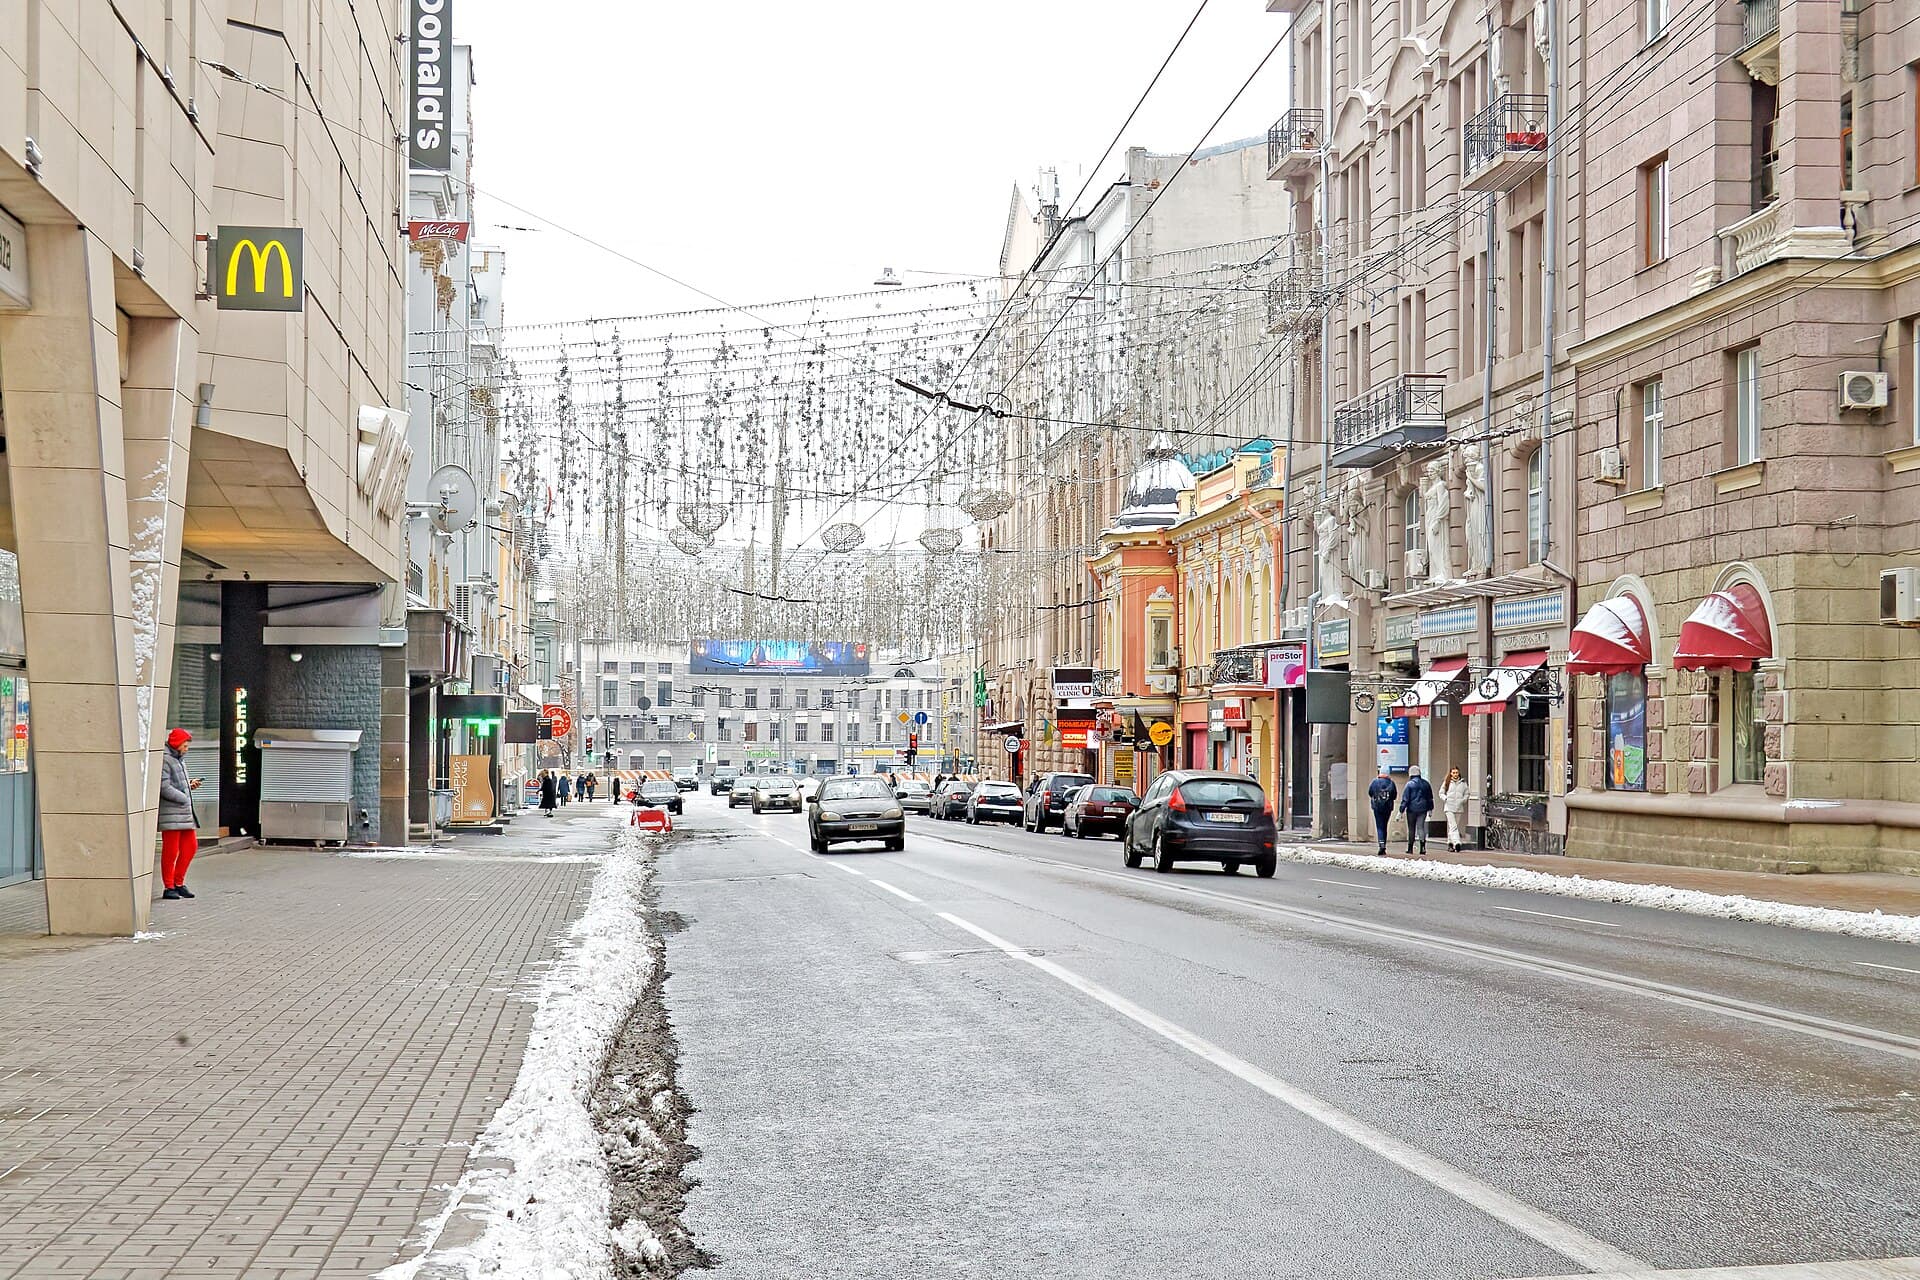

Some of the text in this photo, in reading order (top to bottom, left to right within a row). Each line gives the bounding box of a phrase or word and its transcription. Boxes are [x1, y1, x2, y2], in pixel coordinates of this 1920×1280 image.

[1270, 652, 1303, 662] proStor
[1058, 720, 1096, 730] ЛОМБАРД
[235, 688, 248, 783] PEOPLE
